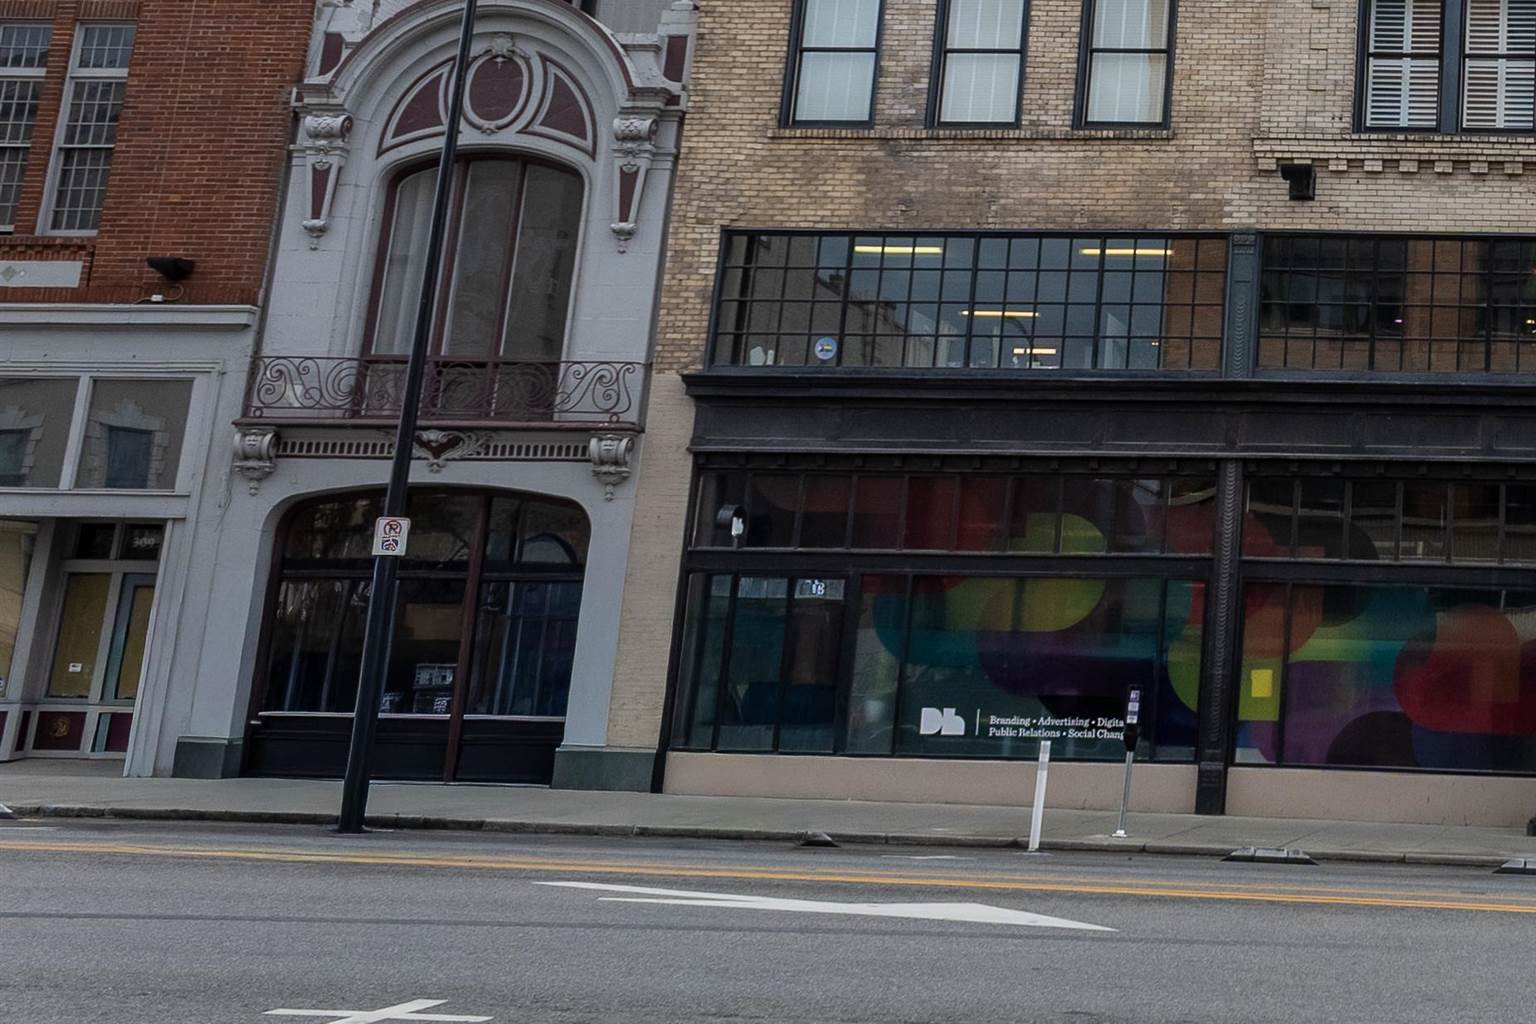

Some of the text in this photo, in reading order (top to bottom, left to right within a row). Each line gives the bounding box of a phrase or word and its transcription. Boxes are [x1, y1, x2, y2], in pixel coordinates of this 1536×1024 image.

[989, 715, 1124, 728] Branding Advertising Digita
[989, 728, 1017, 737] Public
[1018, 728, 1060, 737] Relations
[1068, 729, 1096, 738] Social
